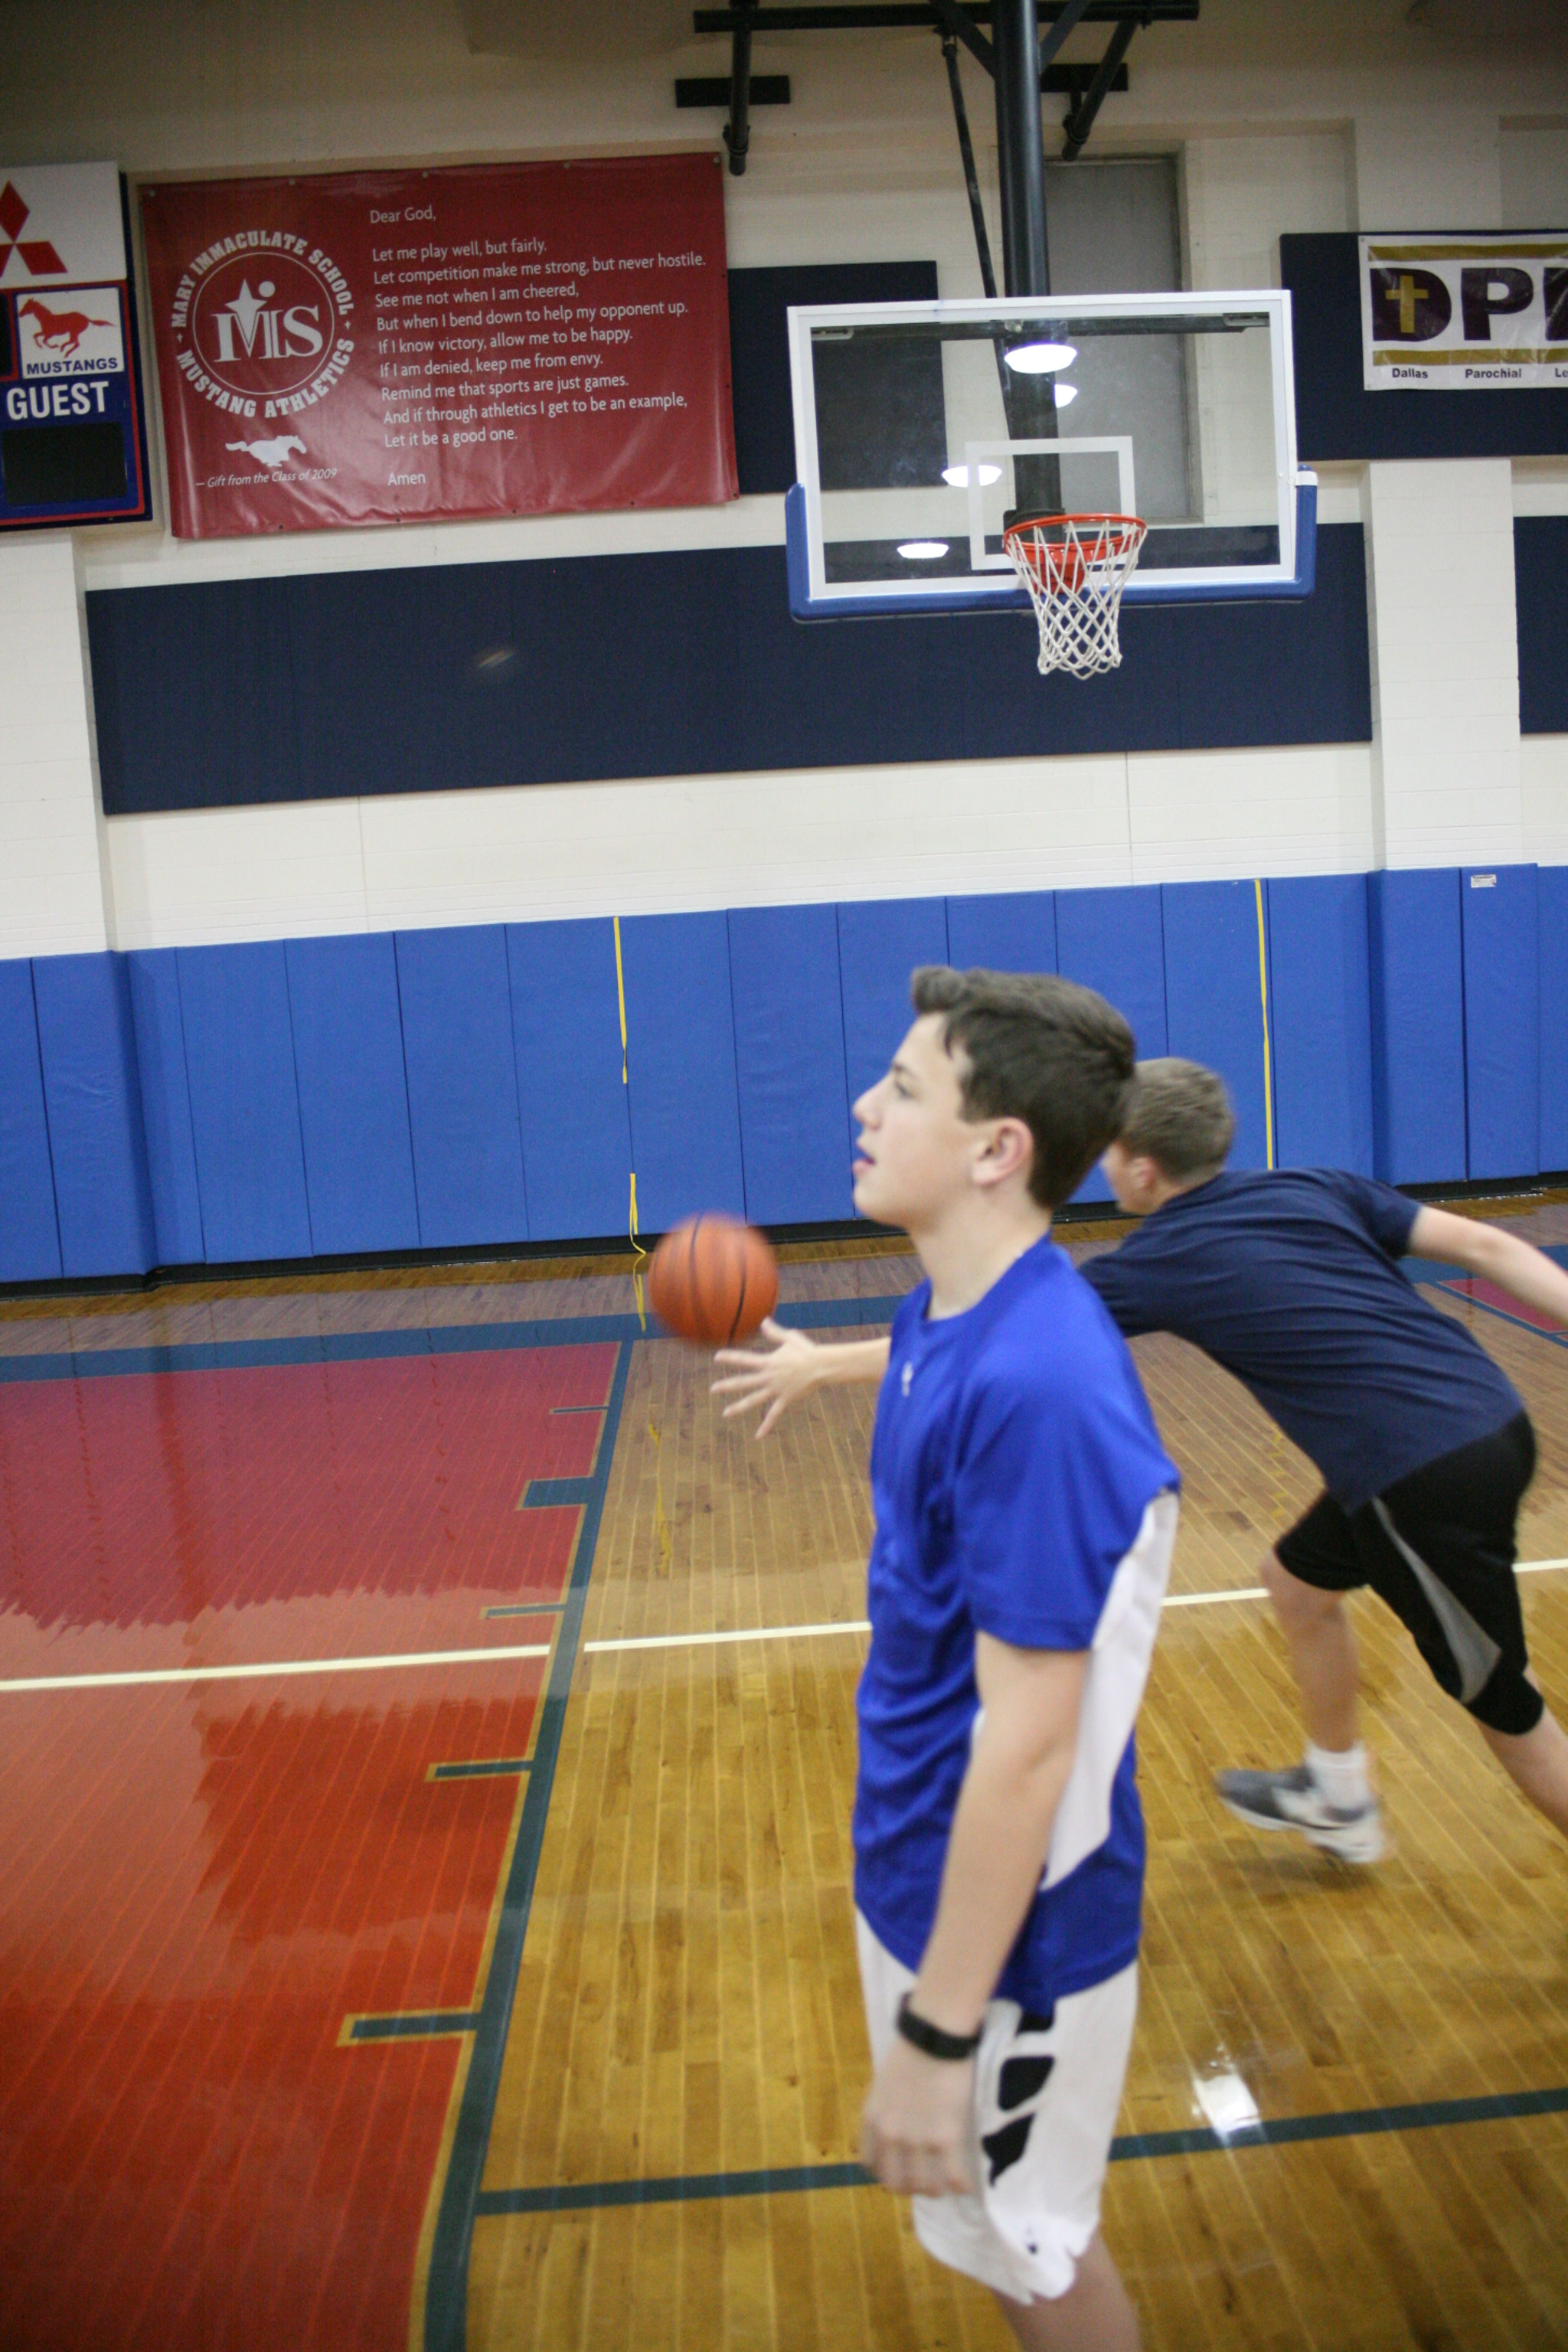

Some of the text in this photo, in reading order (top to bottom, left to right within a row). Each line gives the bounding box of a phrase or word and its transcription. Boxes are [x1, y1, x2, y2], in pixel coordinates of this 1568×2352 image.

[370, 204, 436, 224] Dear God,
[372, 237, 547, 263] Let me play well, but fairly.
[172, 230, 354, 328] MARY IMMACULATE SCHOOL
[374, 250, 706, 286] Let competition make me strong, but never hostile.
[374, 280, 580, 309] See me not when I am cheered,
[377, 301, 688, 332] But when I bend down to help my opponent up.
[377, 325, 633, 354] If I know victory, allow me to be happy.
[27, 358, 118, 375] MUSTANGS
[380, 352, 603, 378] If I am denied, keep me from envy.
[1392, 368, 1429, 379] Dallas
[1465, 368, 1522, 379] Parochial
[176, 338, 354, 419] MUSTANG ATHLETICS
[381, 375, 629, 400] Remind me that sports are just games.
[6, 381, 109, 420] GUEST
[384, 390, 688, 424] And if through athletics I get to be an example,
[384, 426, 518, 449] Let it be a good one.
[207, 475, 226, 488] Gift
[228, 474, 251, 486] from
[253, 472, 269, 484] the
[271, 470, 296, 482] Class
[298, 470, 310, 482] of
[312, 468, 338, 481] 2009
[387, 472, 426, 486] Amen
